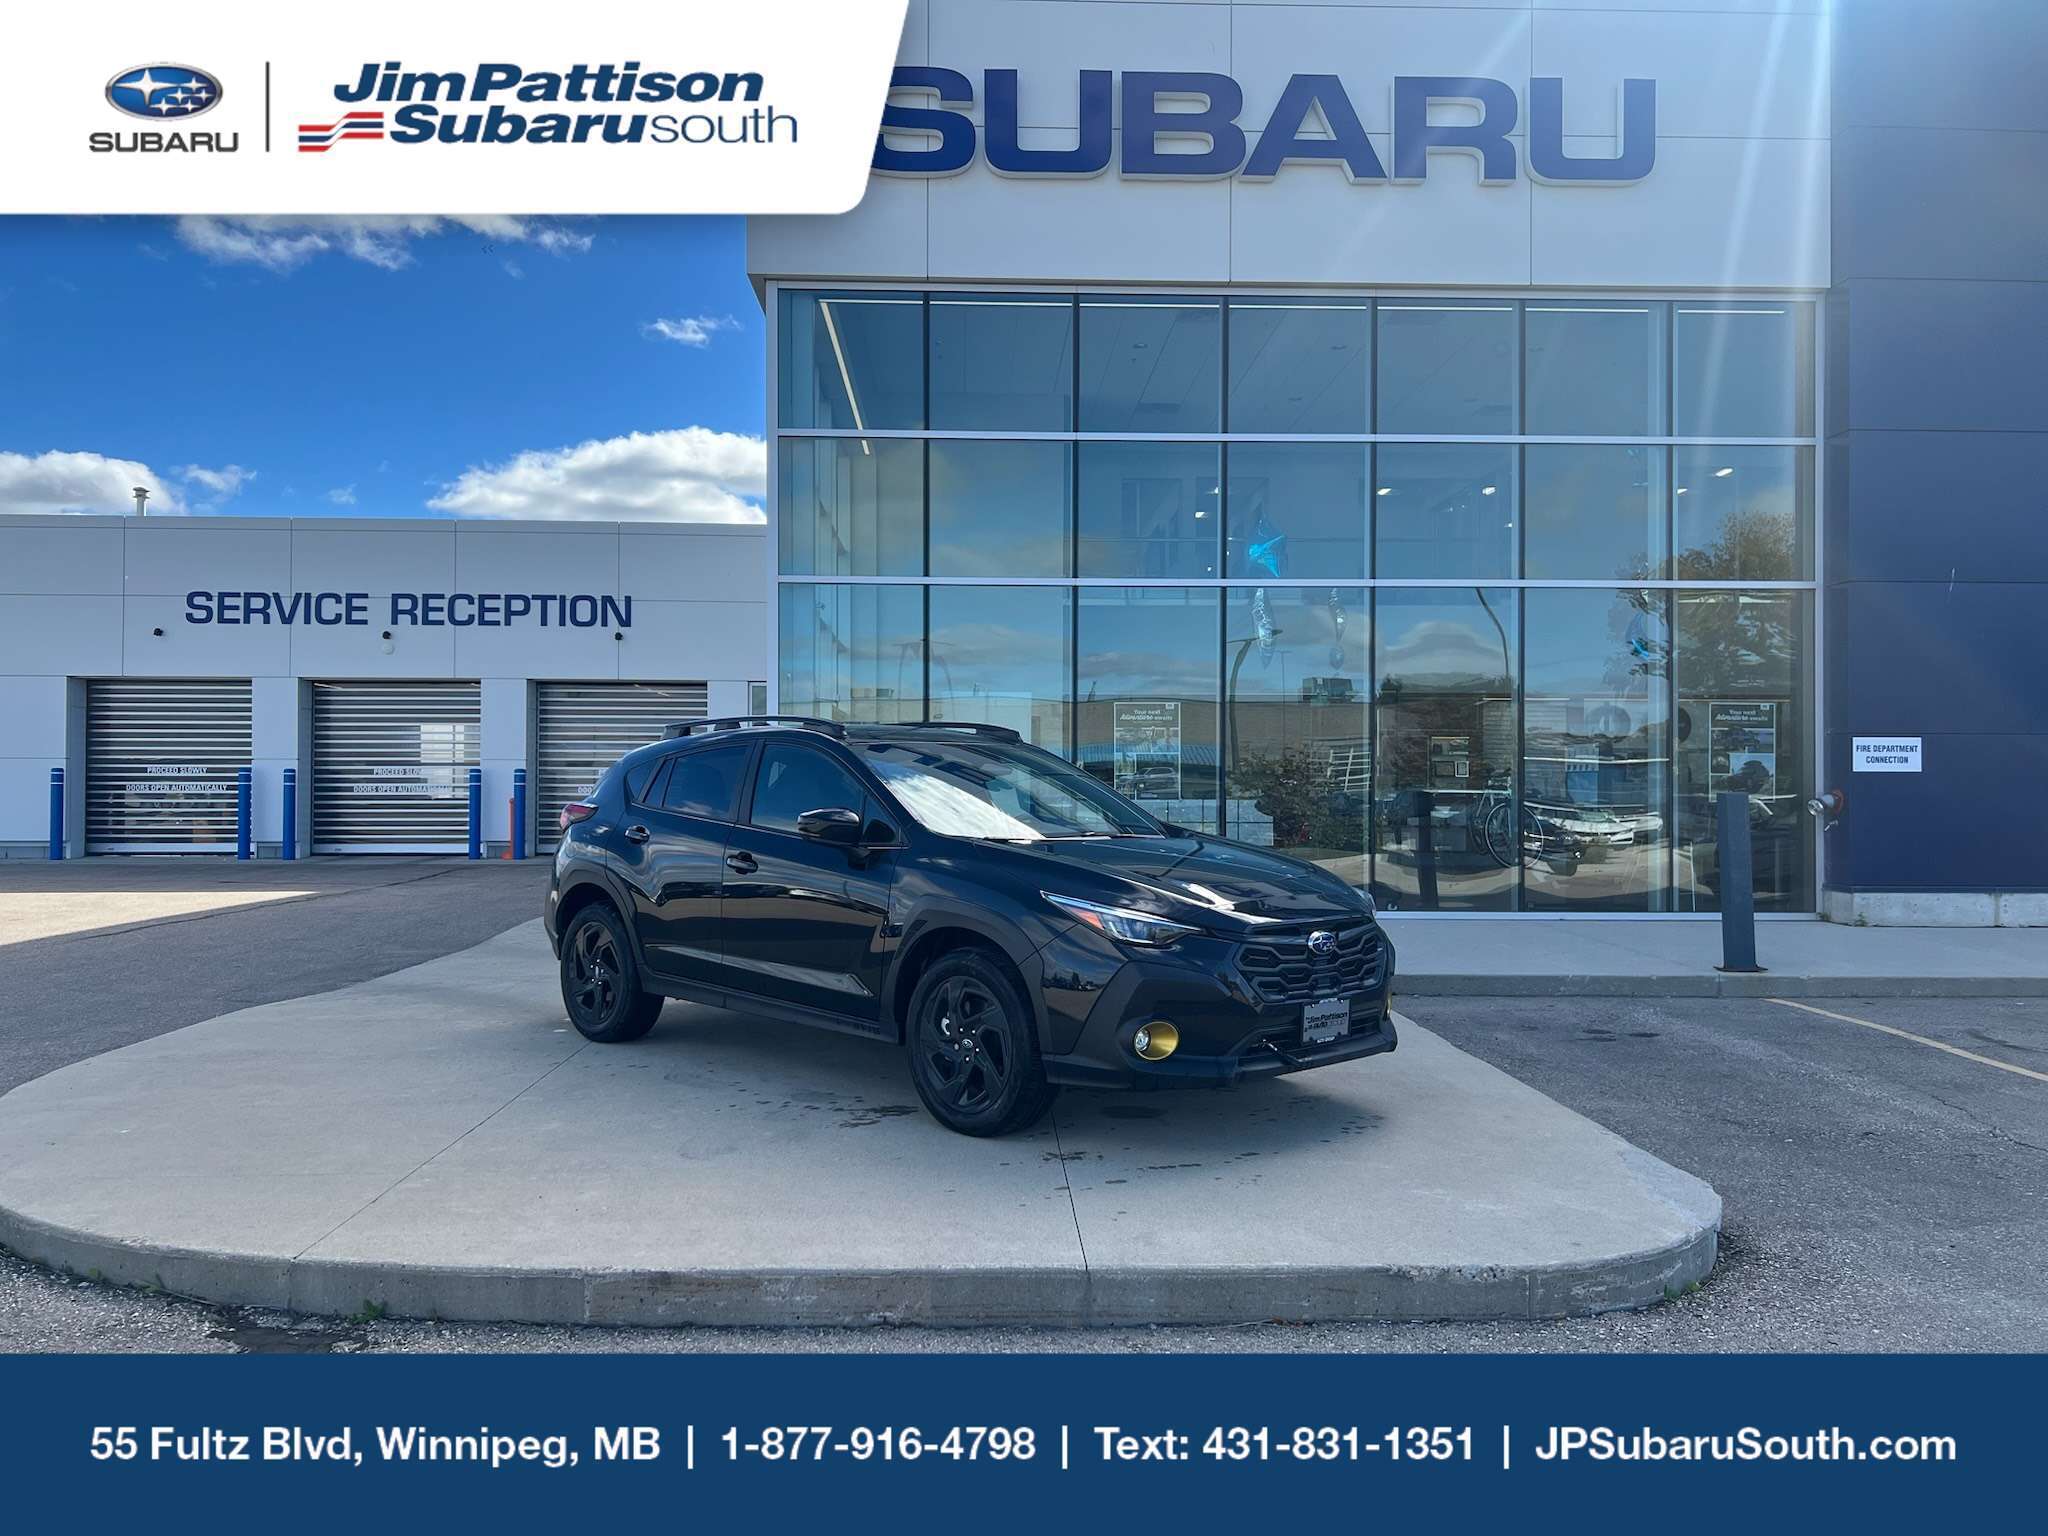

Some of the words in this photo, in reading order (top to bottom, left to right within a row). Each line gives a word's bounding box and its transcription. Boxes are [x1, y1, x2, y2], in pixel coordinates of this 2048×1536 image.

[869, 66, 1656, 184] SUBARU
[185, 591, 369, 625] SERVICE
[390, 593, 632, 627] RECEPTION
[1856, 744, 1871, 753] FIRE
[1873, 744, 1918, 753] DEPARTMENT
[1865, 755, 1909, 764] CONNECTION
[146, 766, 179, 775] PROCEED
[179, 766, 208, 775] SLOWLY
[373, 767, 404, 776] PROCEED
[126, 783, 149, 792] DOORS
[150, 783, 170, 792] OPEN
[170, 783, 228, 792] AUTOMATICALLY
[353, 785, 377, 793] DOORS
[378, 785, 397, 793] OPEN
